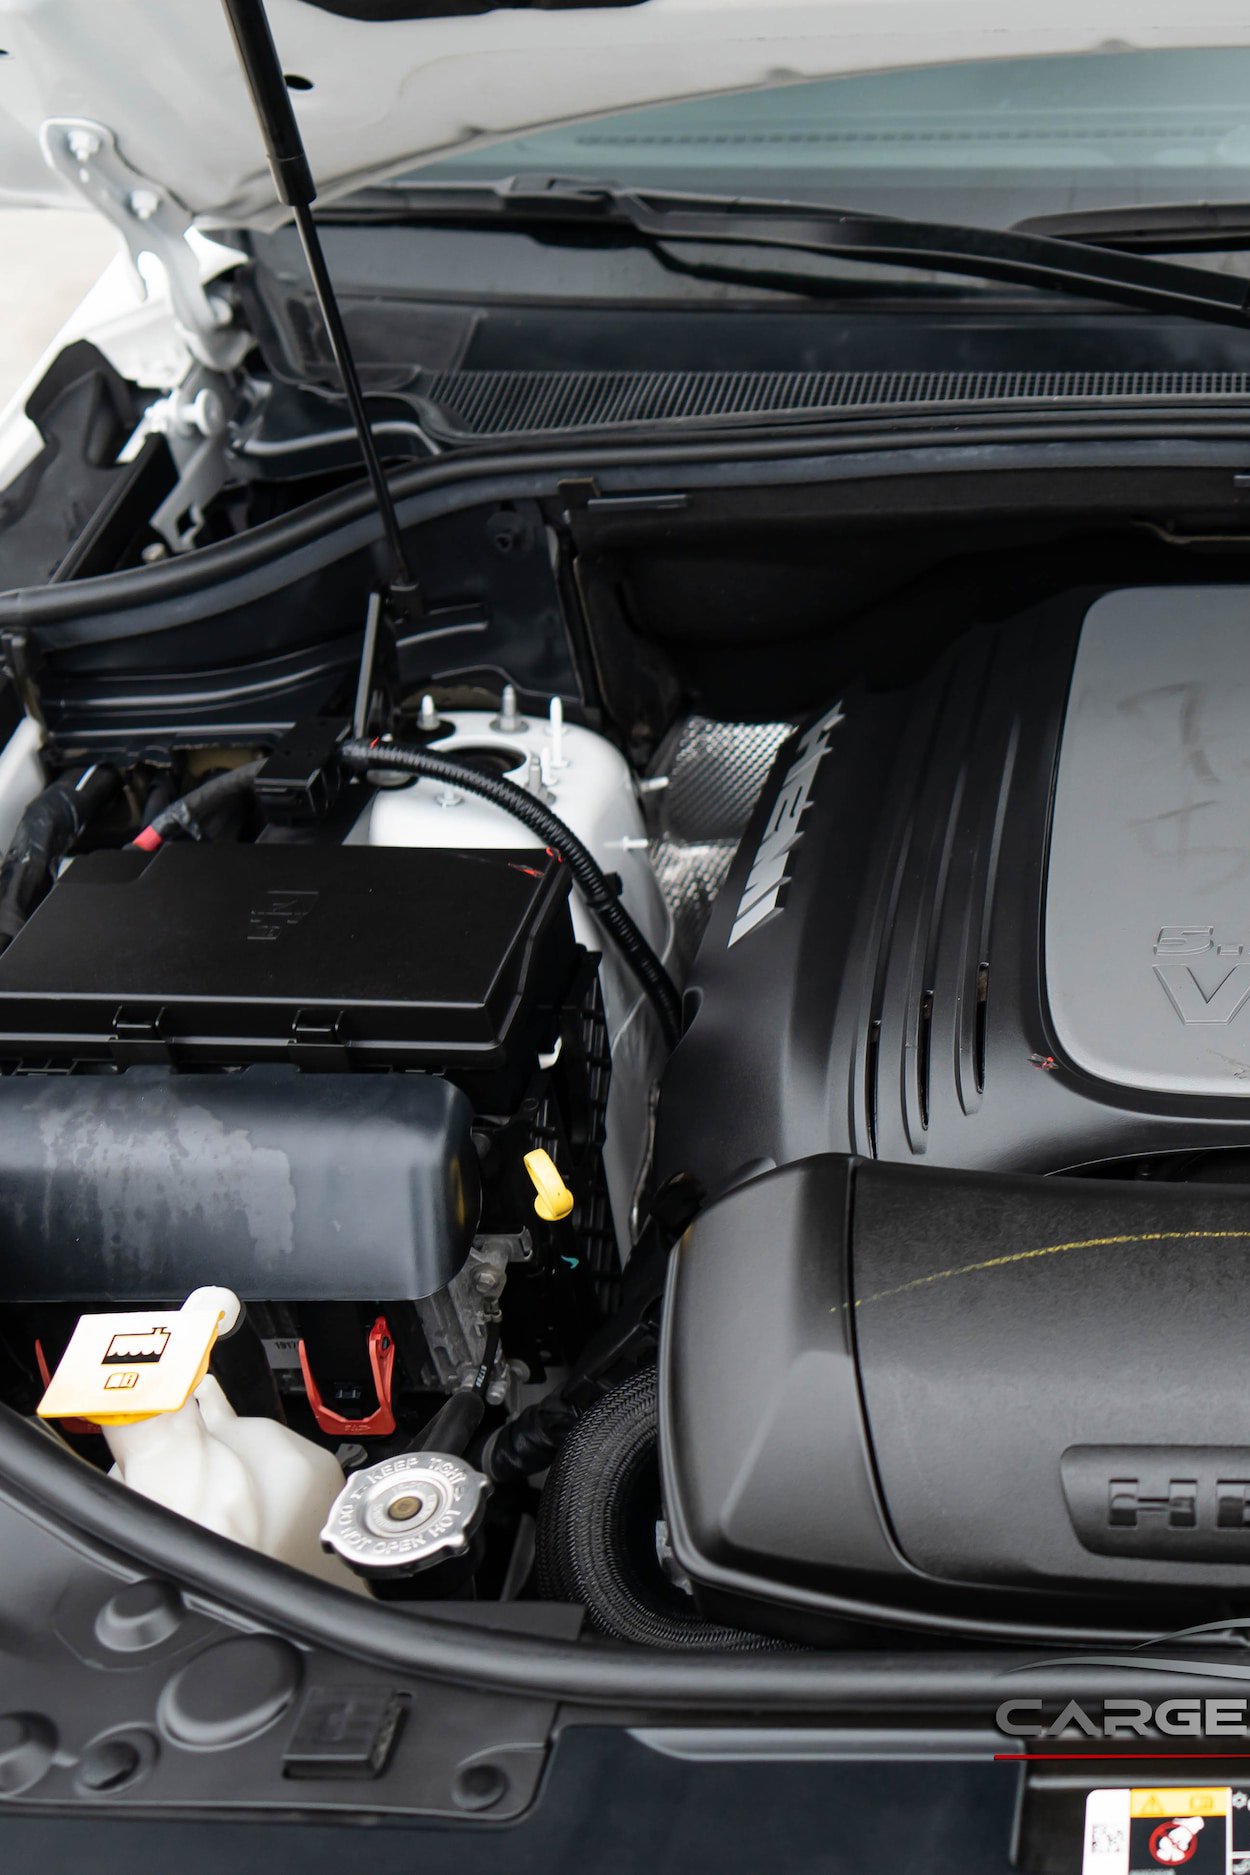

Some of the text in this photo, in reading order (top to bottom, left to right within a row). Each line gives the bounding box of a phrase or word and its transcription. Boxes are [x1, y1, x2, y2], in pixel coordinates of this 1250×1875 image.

[367, 1457, 468, 1484] KEEP TIGHT
[340, 1528, 372, 1549] NOT
[374, 1534, 427, 1554] OPEN
[429, 1509, 462, 1538] HOT
